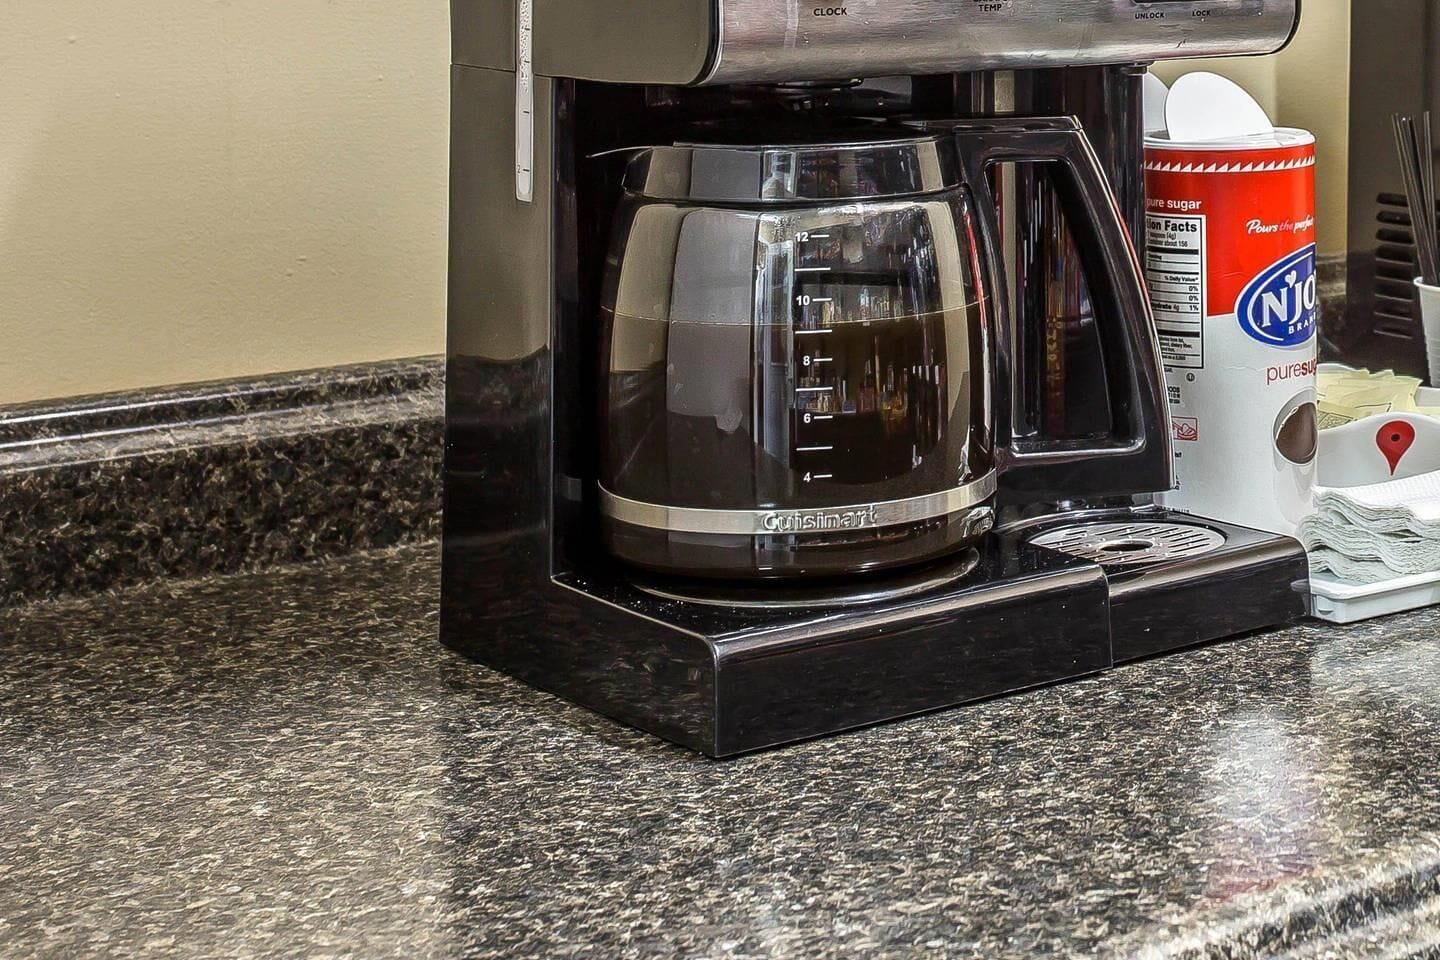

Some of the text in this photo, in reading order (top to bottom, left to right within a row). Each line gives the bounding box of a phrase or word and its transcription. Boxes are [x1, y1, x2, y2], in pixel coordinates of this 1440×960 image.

[813, 7, 848, 17] CLOCK
[978, 3, 1002, 12] TEMP
[1192, 9, 1211, 17] LOCK
[1135, 11, 1165, 20] UNLOCK
[1146, 199, 1202, 212] pure sugar
[1164, 220, 1198, 233] Facts
[1246, 218, 1279, 235] Pours
[1279, 220, 1294, 232] the
[795, 231, 809, 242] 12
[796, 295, 810, 306] 10
[1261, 269, 1317, 328] NJO
[1288, 312, 1316, 335] BRAN
[803, 355, 811, 366] 8
[803, 413, 811, 424] 6
[803, 471, 811, 483] 4
[763, 504, 878, 532] Cuisinart
